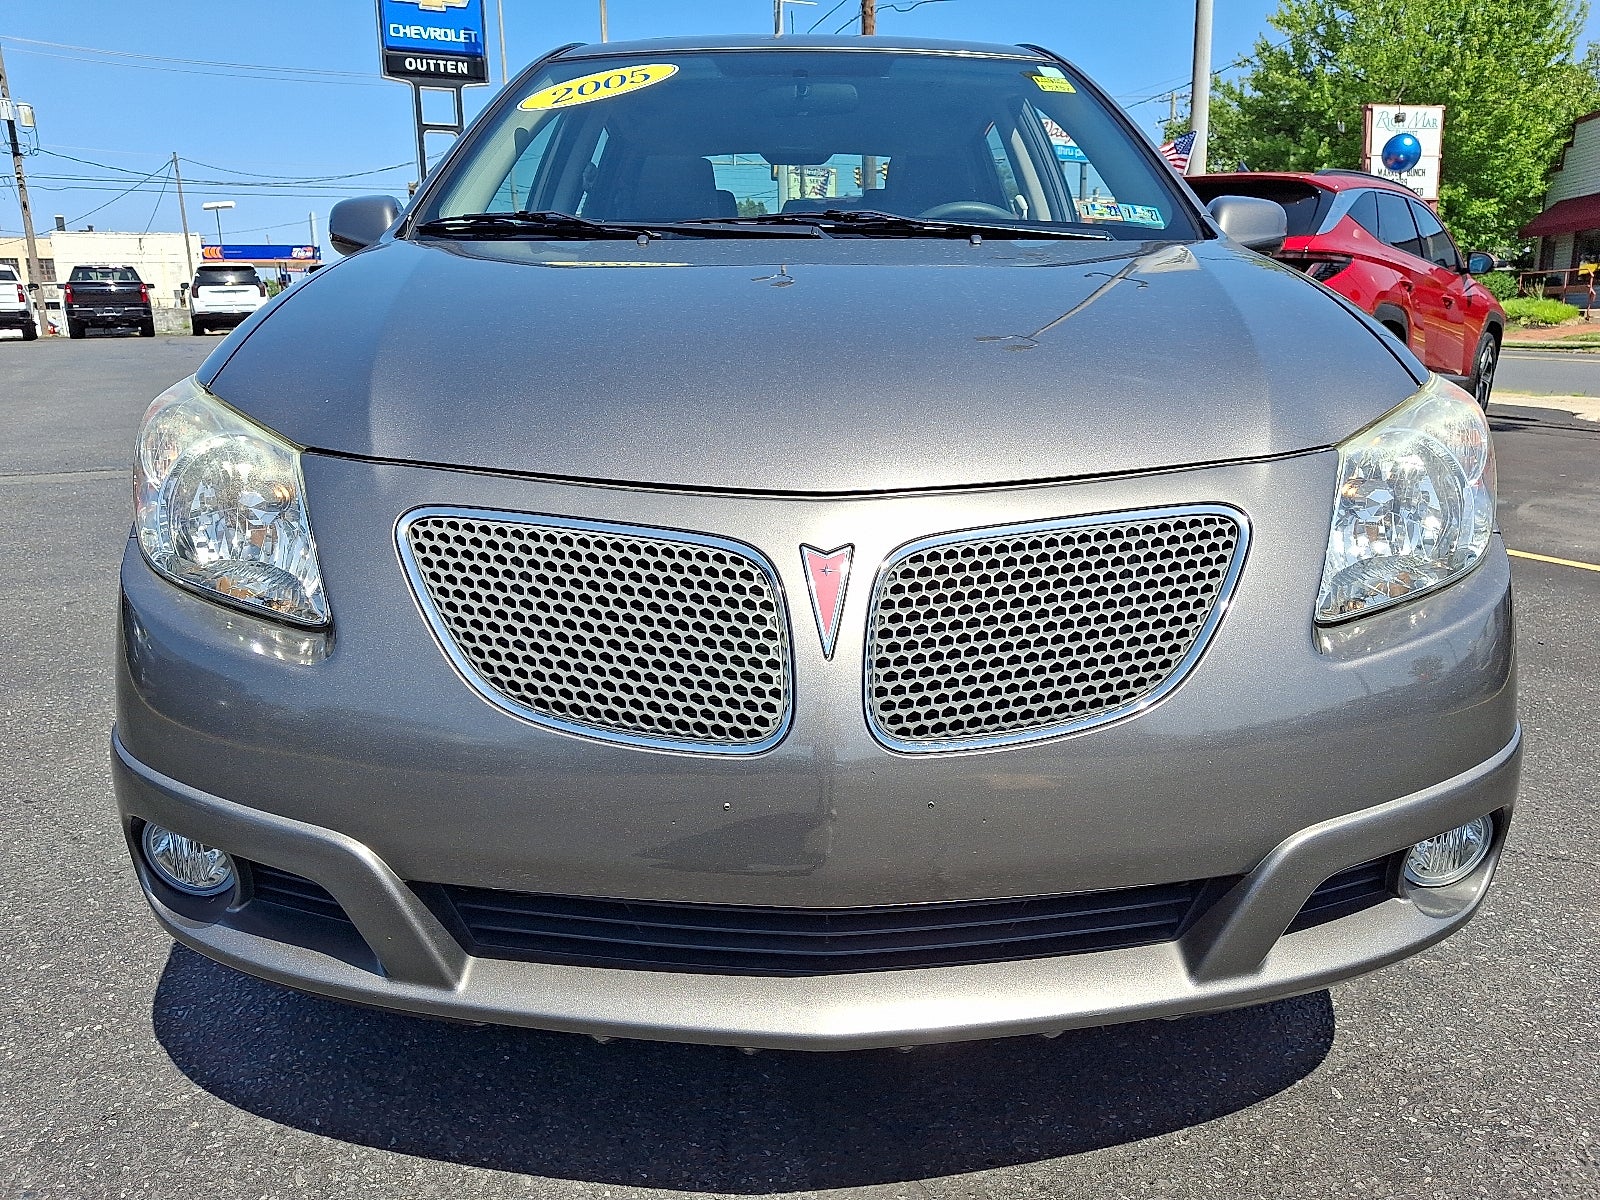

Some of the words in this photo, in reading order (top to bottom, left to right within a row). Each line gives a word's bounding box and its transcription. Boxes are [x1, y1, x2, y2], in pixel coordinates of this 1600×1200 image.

[389, 23, 477, 43] CHEVROLET
[404, 57, 468, 75] OUTTEN
[551, 67, 651, 105] 2005
